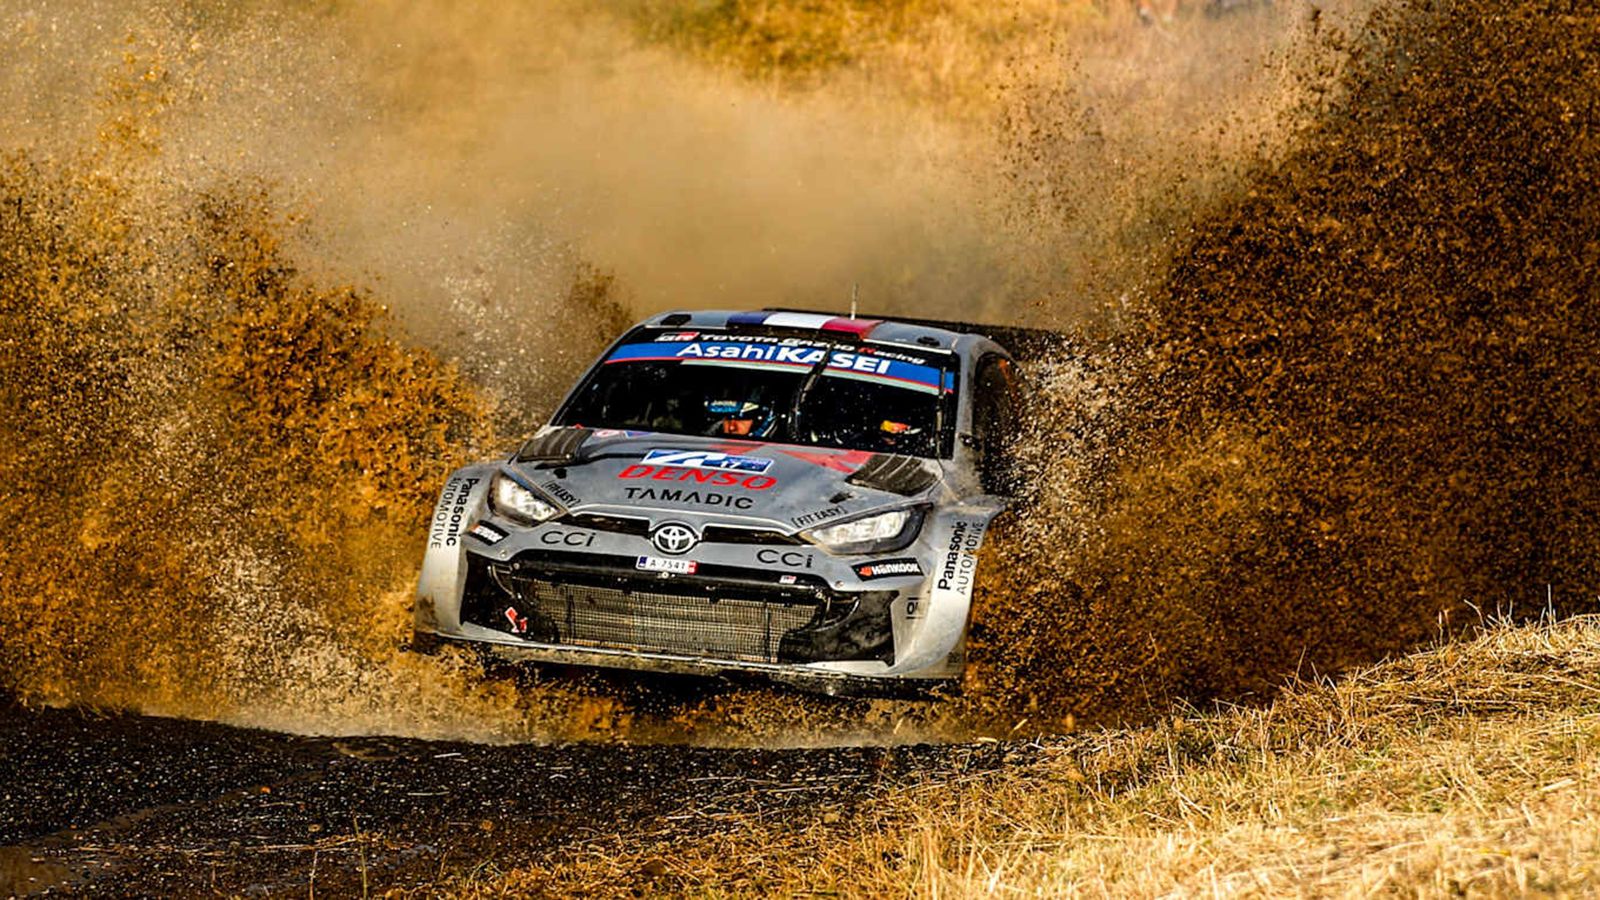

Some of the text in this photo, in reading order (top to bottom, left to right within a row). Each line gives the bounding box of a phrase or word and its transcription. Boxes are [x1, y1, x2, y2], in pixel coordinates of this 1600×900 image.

[700, 334, 779, 343] TOYOTA
[618, 464, 778, 491] DENSO
[624, 487, 754, 509] TAMADIC
[430, 477, 462, 549] AUTOMOTIVE
[446, 478, 480, 547] Panasonic
[937, 521, 968, 591] Panasonic
